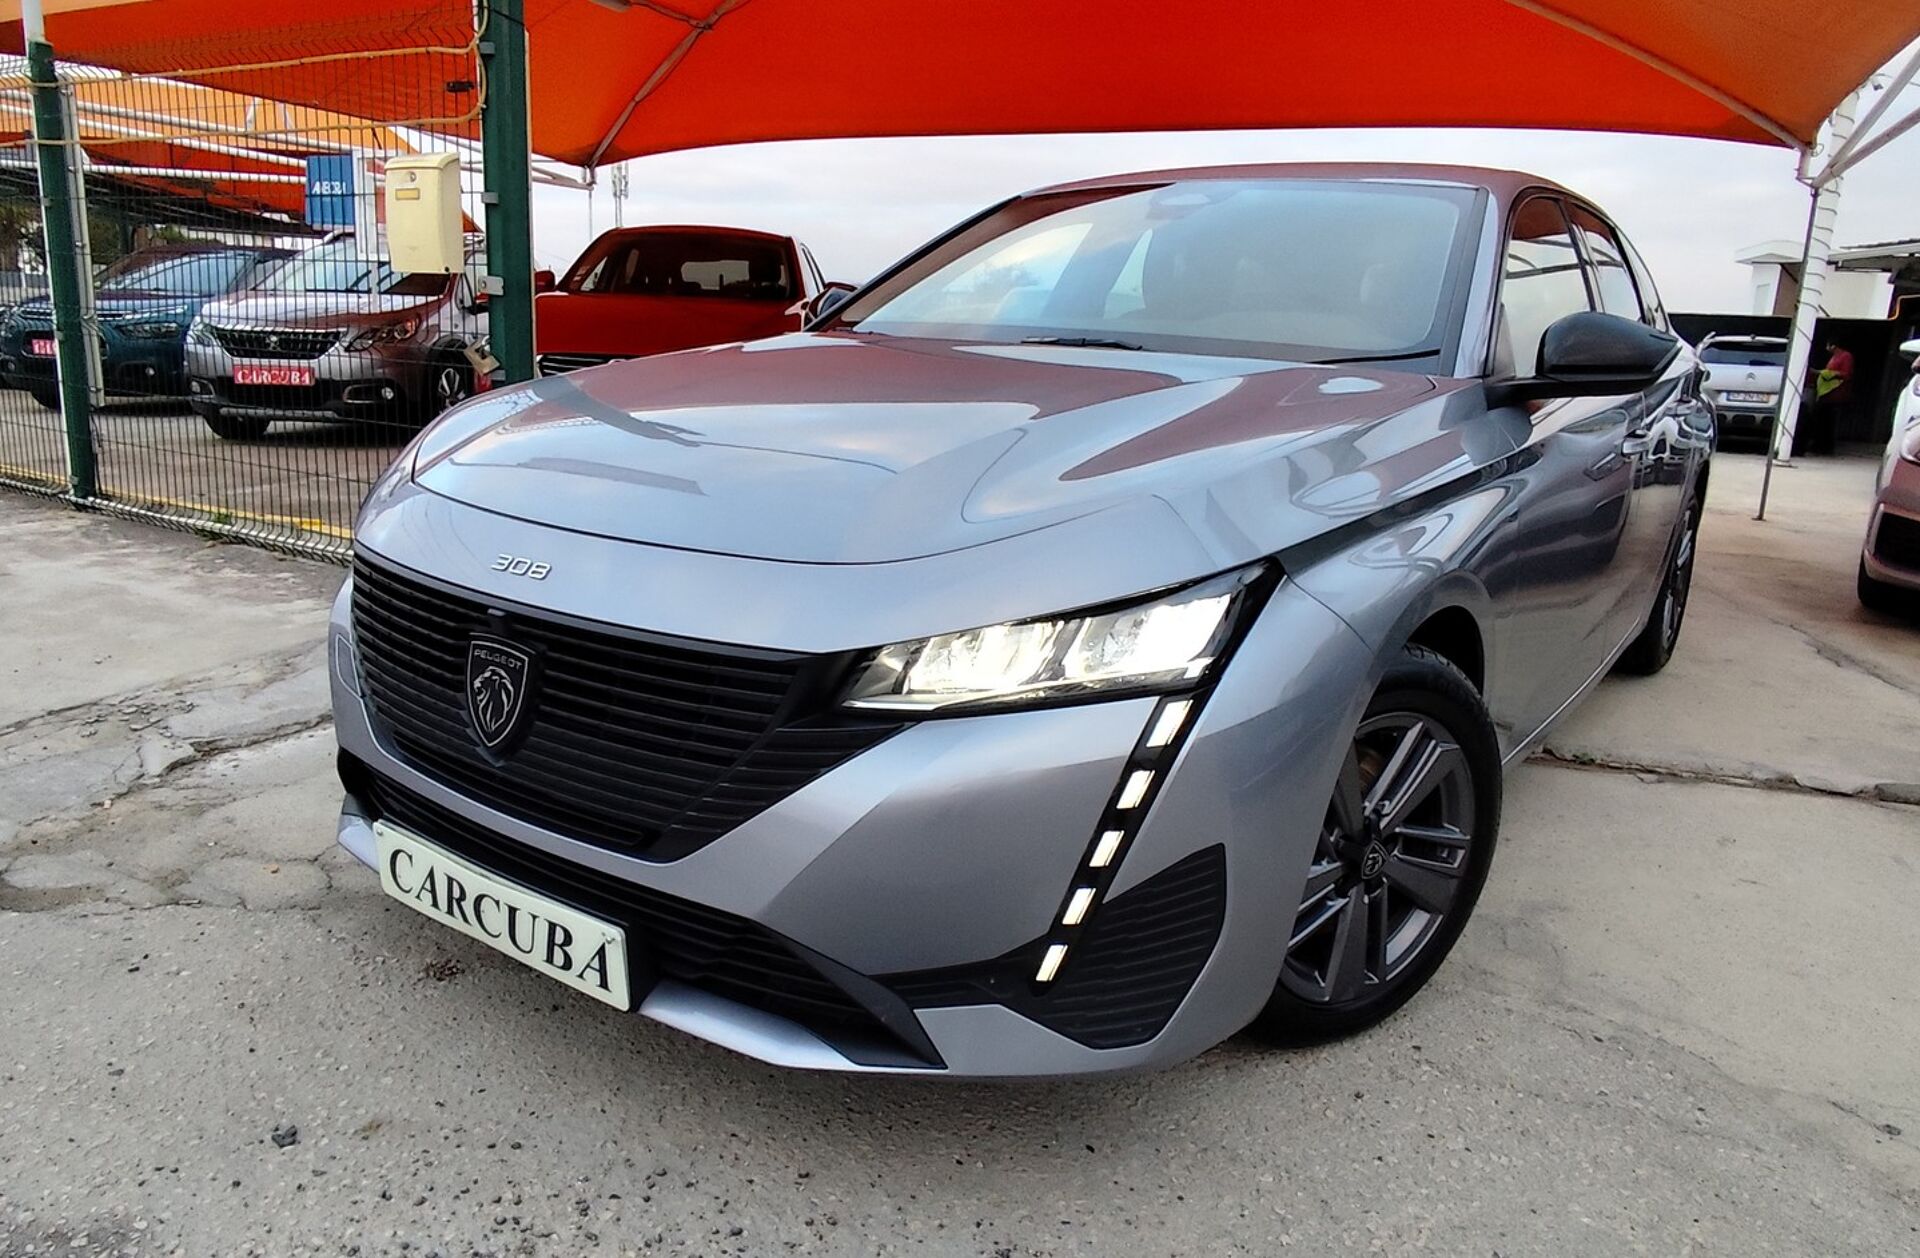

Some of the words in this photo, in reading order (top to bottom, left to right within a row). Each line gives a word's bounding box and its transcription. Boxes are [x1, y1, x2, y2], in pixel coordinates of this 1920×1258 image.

[237, 369, 310, 385] CARCUBA
[491, 553, 552, 580] 308
[474, 648, 523, 670] PEUGEOT
[389, 848, 613, 993] CARCUBA
